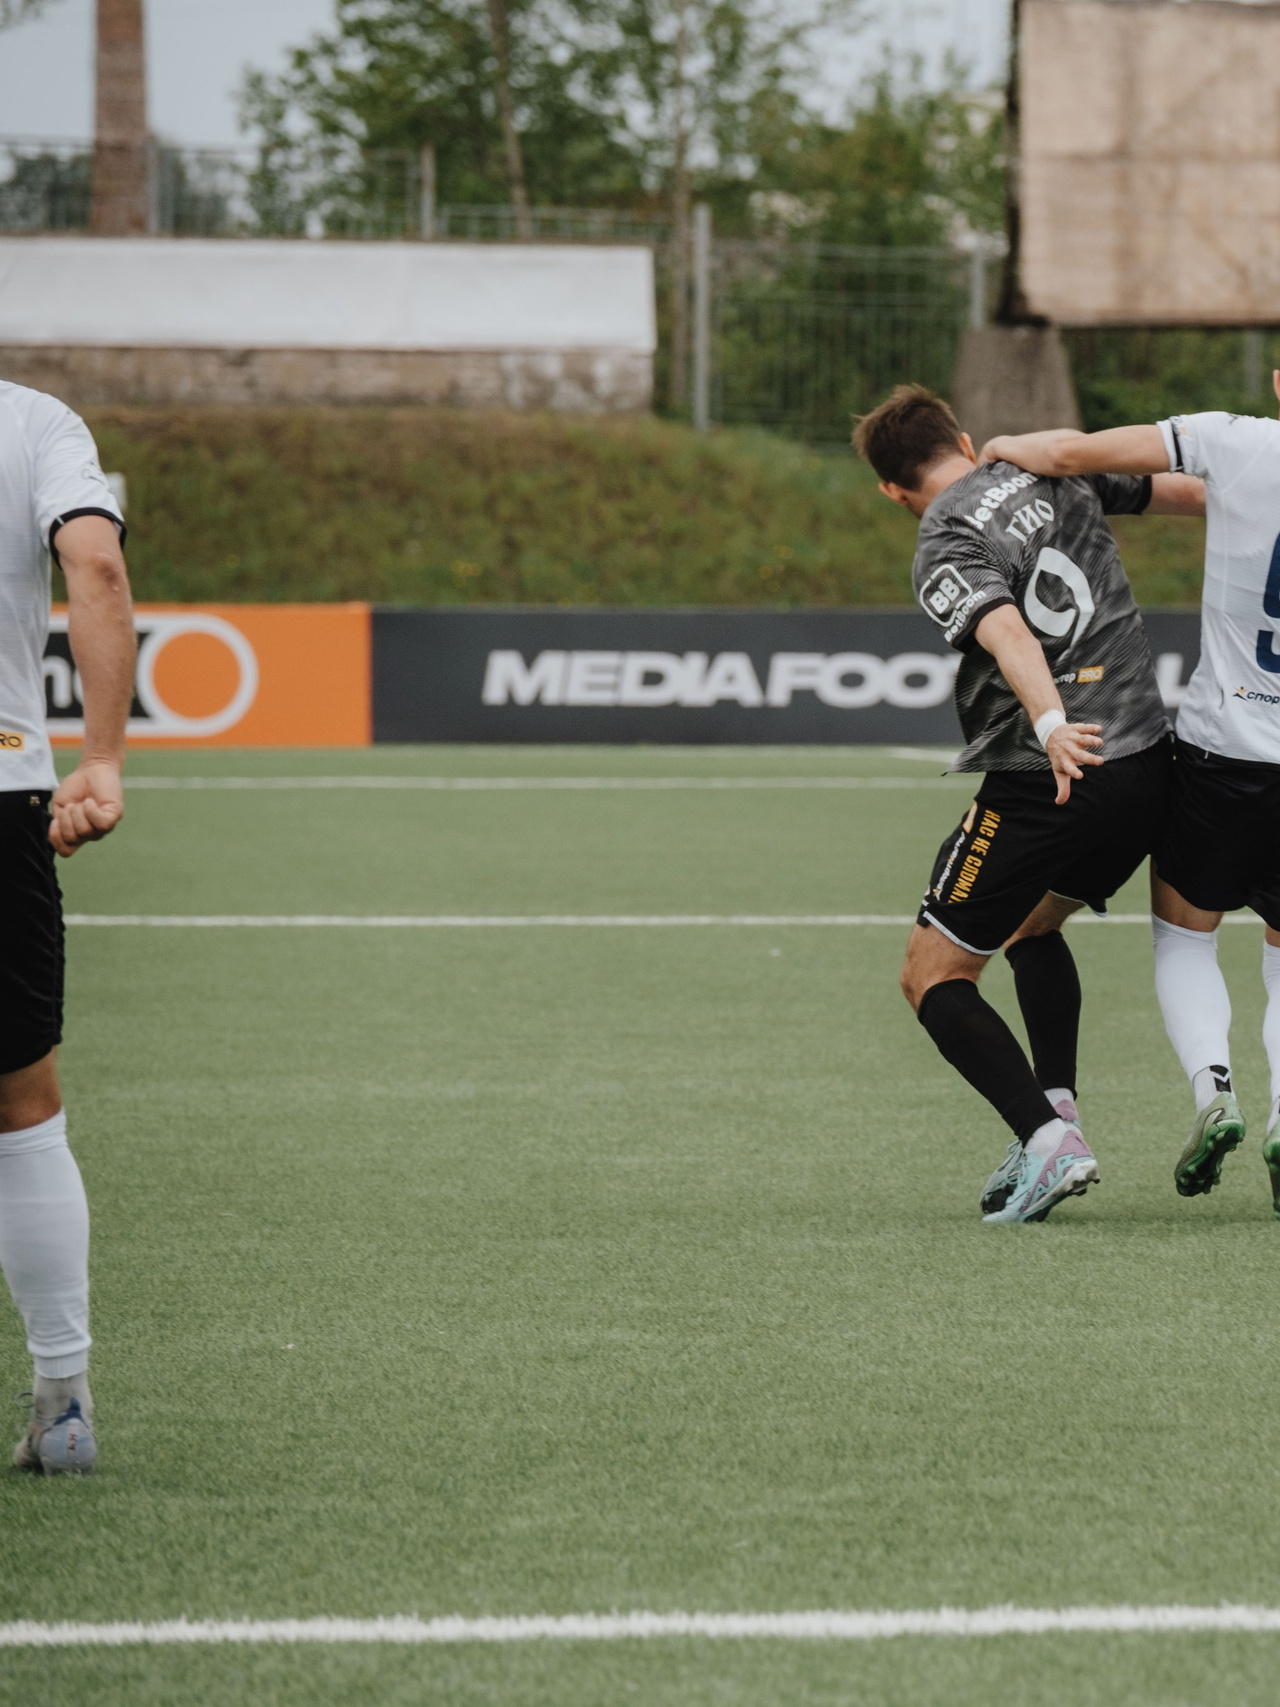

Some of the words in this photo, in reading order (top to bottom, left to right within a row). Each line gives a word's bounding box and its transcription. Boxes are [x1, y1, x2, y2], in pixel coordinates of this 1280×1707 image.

[929, 577, 960, 615] BB
[944, 590, 987, 643] BetBoom
[1024, 547, 1095, 664] 9
[482, 650, 764, 707] MEDIA
[0, 733, 22, 748] RO
[979, 809, 1001, 838] НАС
[970, 836, 991, 857] НЕ
[947, 854, 983, 903] СЛОМАТ
